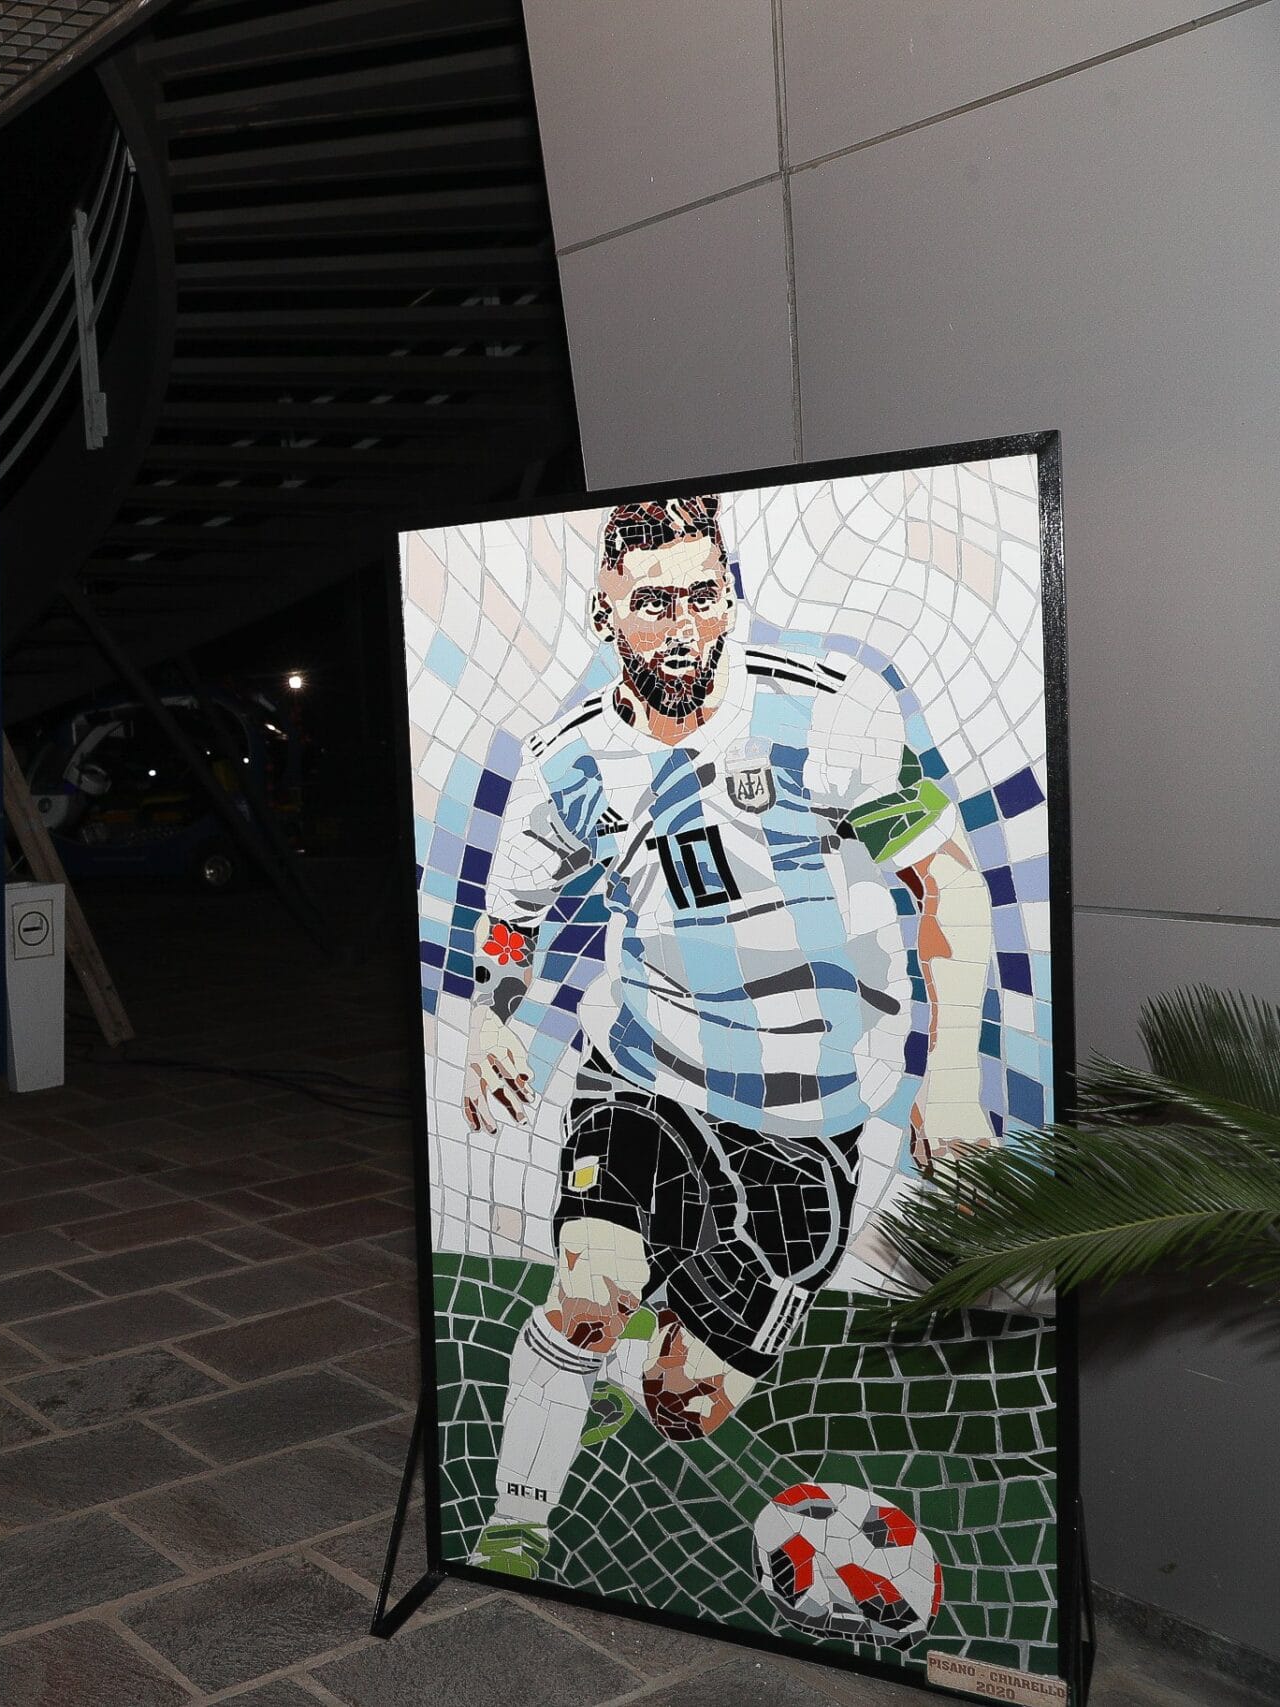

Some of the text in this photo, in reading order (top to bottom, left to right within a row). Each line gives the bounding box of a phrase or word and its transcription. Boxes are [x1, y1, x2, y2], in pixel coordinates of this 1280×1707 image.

[737, 769, 766, 801] AFA
[644, 824, 743, 911] 10
[928, 1657, 976, 1677] PISANO
[989, 1671, 1066, 1699] CHIARELLO
[976, 1681, 1016, 1700] 2020
